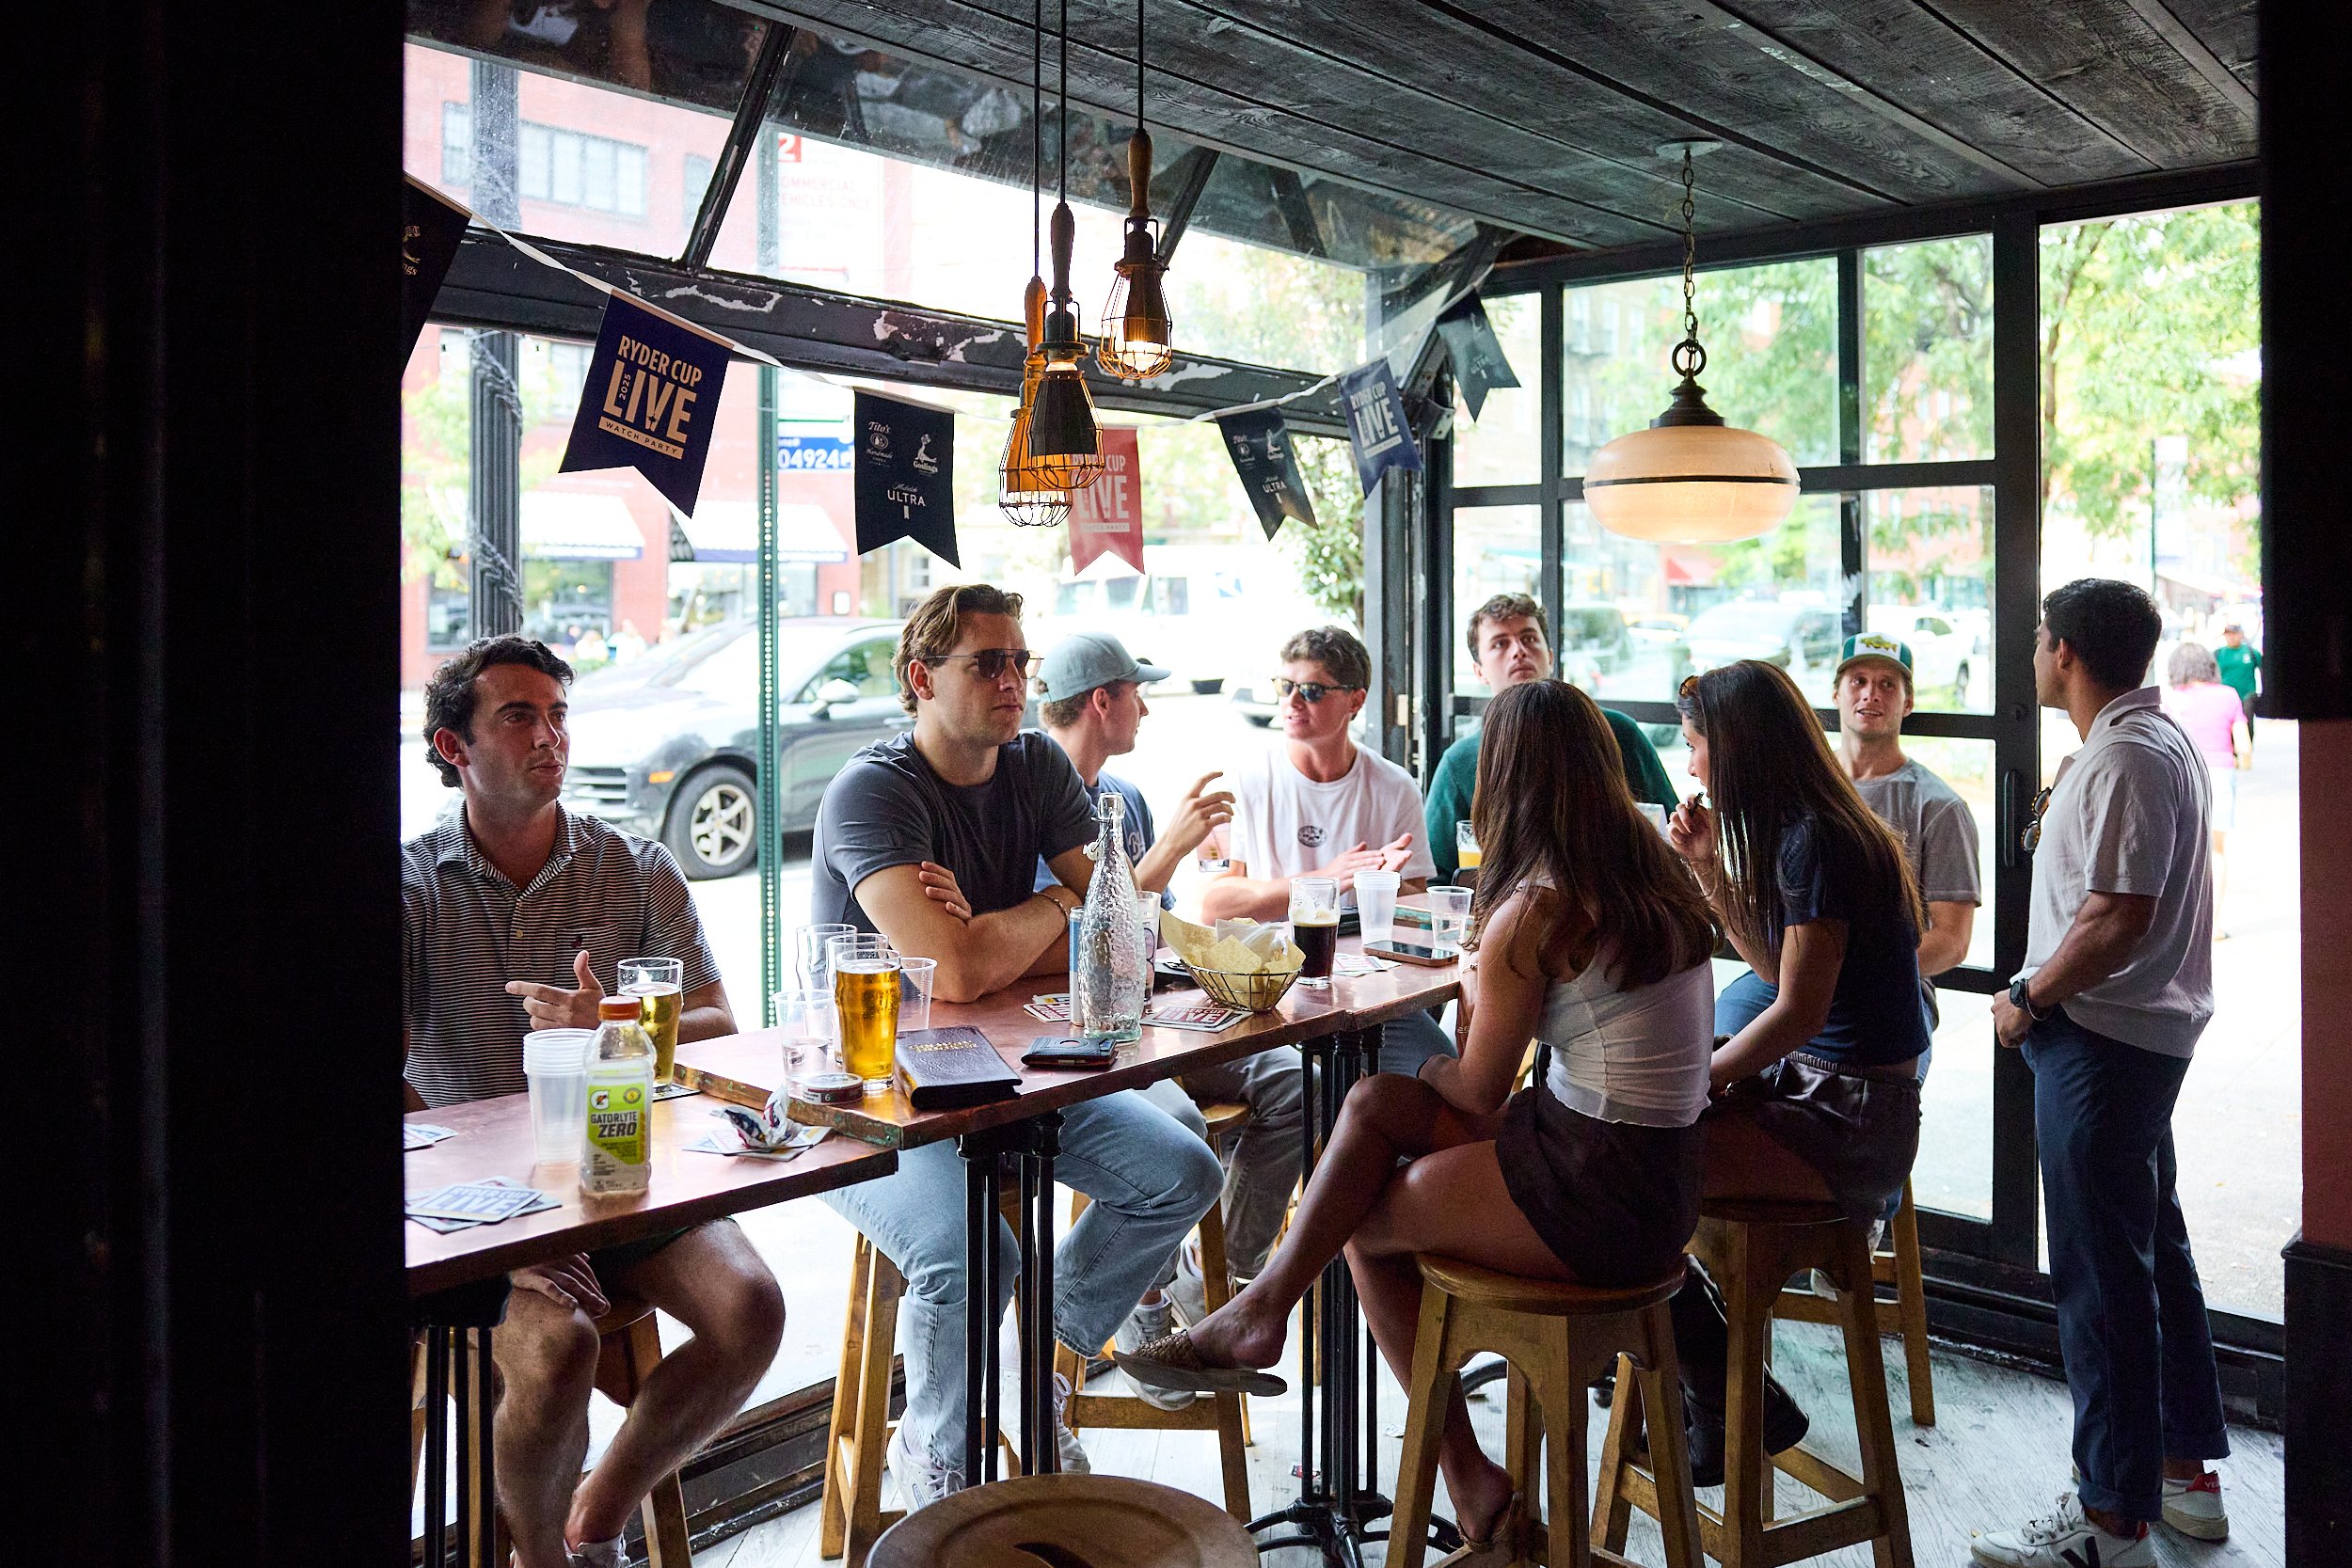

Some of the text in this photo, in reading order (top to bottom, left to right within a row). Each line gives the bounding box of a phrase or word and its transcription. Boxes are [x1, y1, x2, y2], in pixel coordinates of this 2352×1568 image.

[779, 134, 796, 162] 2
[780, 175, 857, 192] OMMERCIAL
[780, 193, 837, 208] EHICLES
[617, 335, 703, 388] RYDER CUP
[618, 373, 631, 401] 2025
[603, 359, 697, 444] LIVE
[867, 421, 891, 434] Tito's
[1354, 397, 1399, 449] LIVE
[605, 421, 678, 455] WATCH PARTY
[777, 448, 840, 468] 04924
[1106, 454, 1126, 472] CUP
[1262, 480, 1287, 494] ULTRA
[887, 489, 926, 507] ULTRA
[1073, 474, 1130, 519] LIVE
[1158, 1010, 1221, 1022] LIVE
[591, 1111, 637, 1124] GATORLYTE
[598, 1122, 637, 1138] ZERO
[450, 1187, 530, 1199] RYDER CUP
[423, 1194, 521, 1214] LIVE
